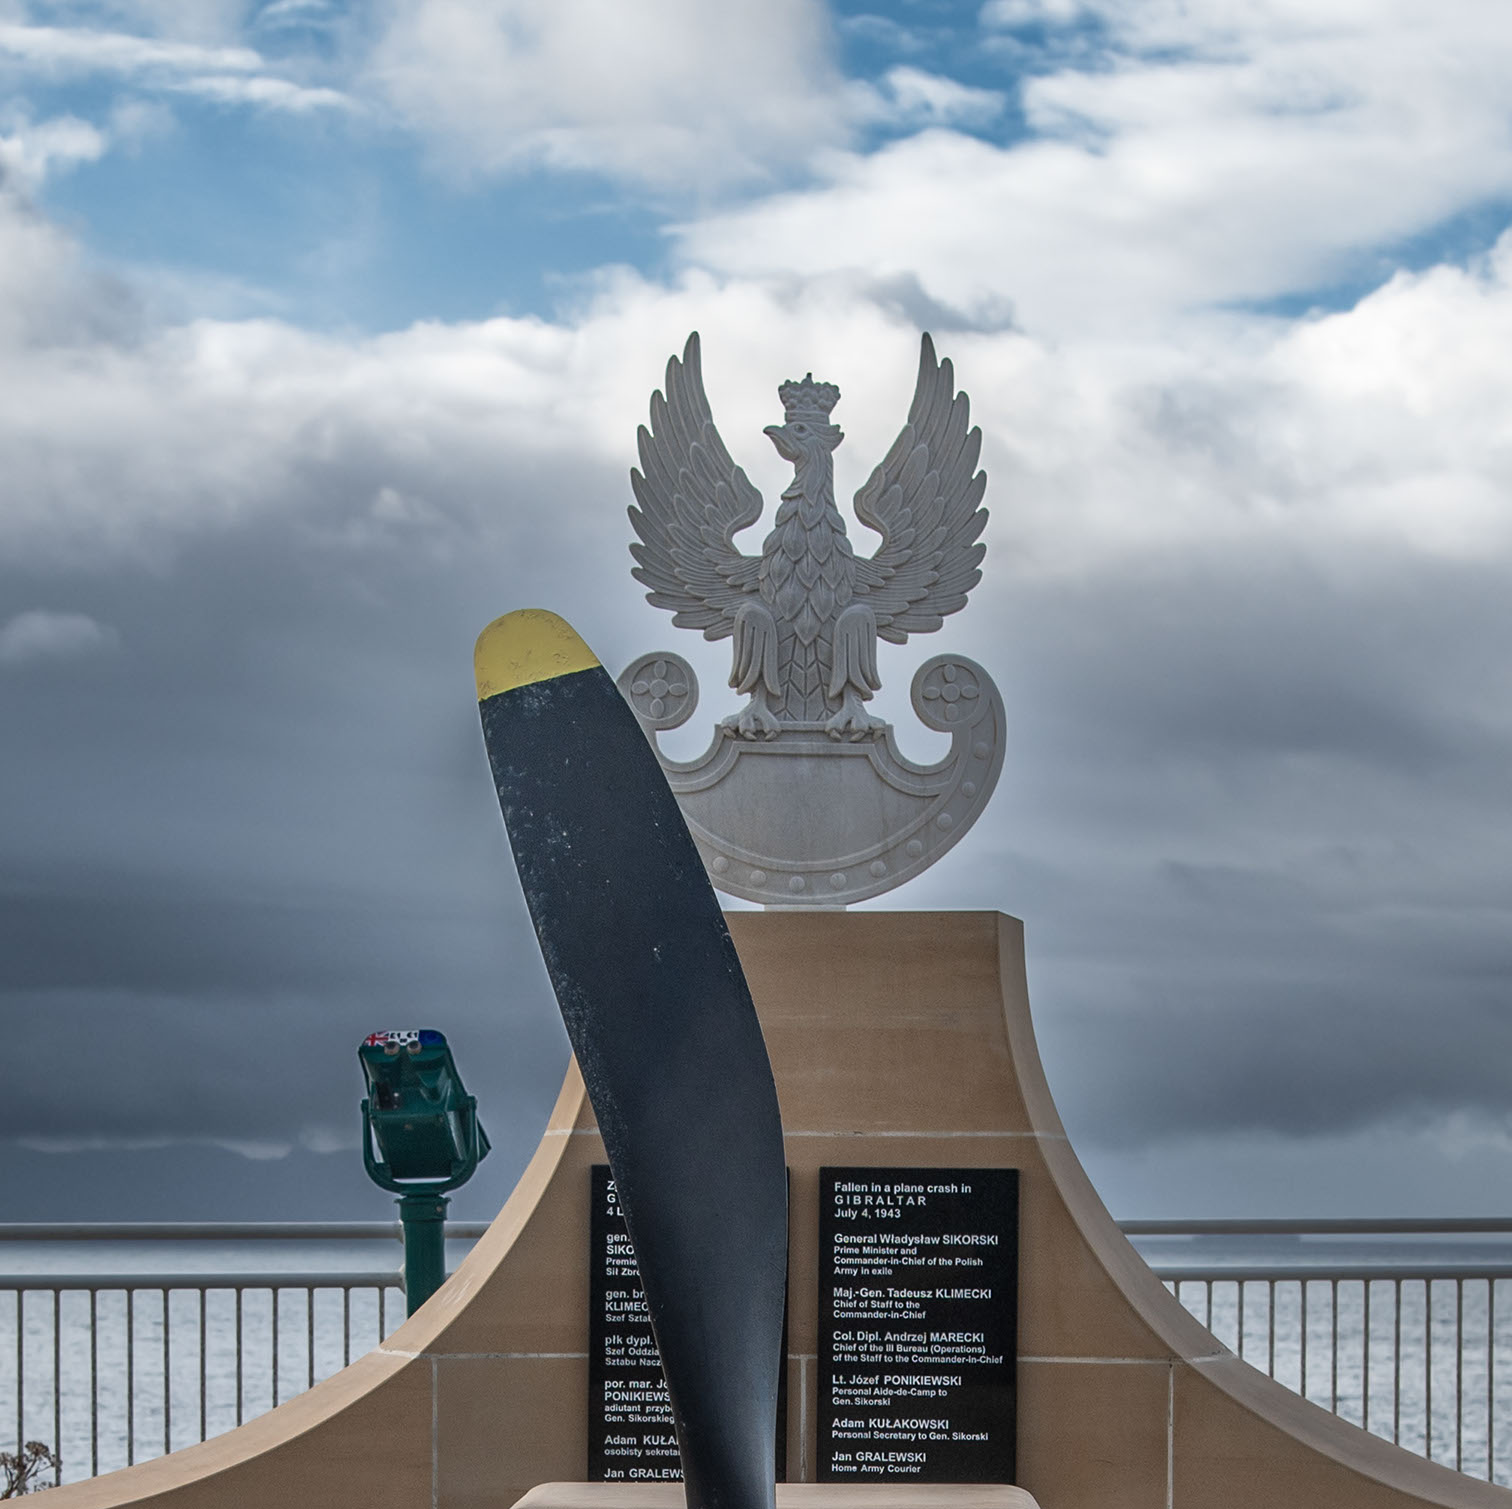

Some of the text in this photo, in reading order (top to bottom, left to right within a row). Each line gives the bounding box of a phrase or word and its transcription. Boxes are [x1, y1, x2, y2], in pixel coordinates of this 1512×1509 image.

[833, 1181, 972, 1195] Fallen in a plane crash in
[833, 1207, 901, 1220] July 4, 1943
[605, 1233, 630, 1244] gen.
[833, 1232, 998, 1247] General Władysław SIKORSKI
[833, 1245, 917, 1255] Prime Minister and
[833, 1265, 893, 1277] Army in exile
[832, 1286, 992, 1300] Maj.-Gen. Tadeusz KLIMECKI
[604, 1334, 653, 1347] płk dypl.
[832, 1330, 984, 1345] Col. Dipl. Andrzej MARECKI
[604, 1346, 625, 1355] Szef
[604, 1356, 637, 1366] Sztabu
[831, 1373, 962, 1386] Lt. Józef PONIKIEWSKI
[831, 1396, 891, 1406] Gen. Sikorski
[603, 1403, 672, 1413] adiutant przyb
[603, 1412, 626, 1422] Gen.
[831, 1417, 949, 1430] Adam KUŁAKOWSKI
[603, 1434, 637, 1445] Adam
[831, 1450, 926, 1463] Jan GRALEWSKI
[603, 1467, 625, 1478] Jan
[830, 1462, 921, 1474] Home Army Courier
